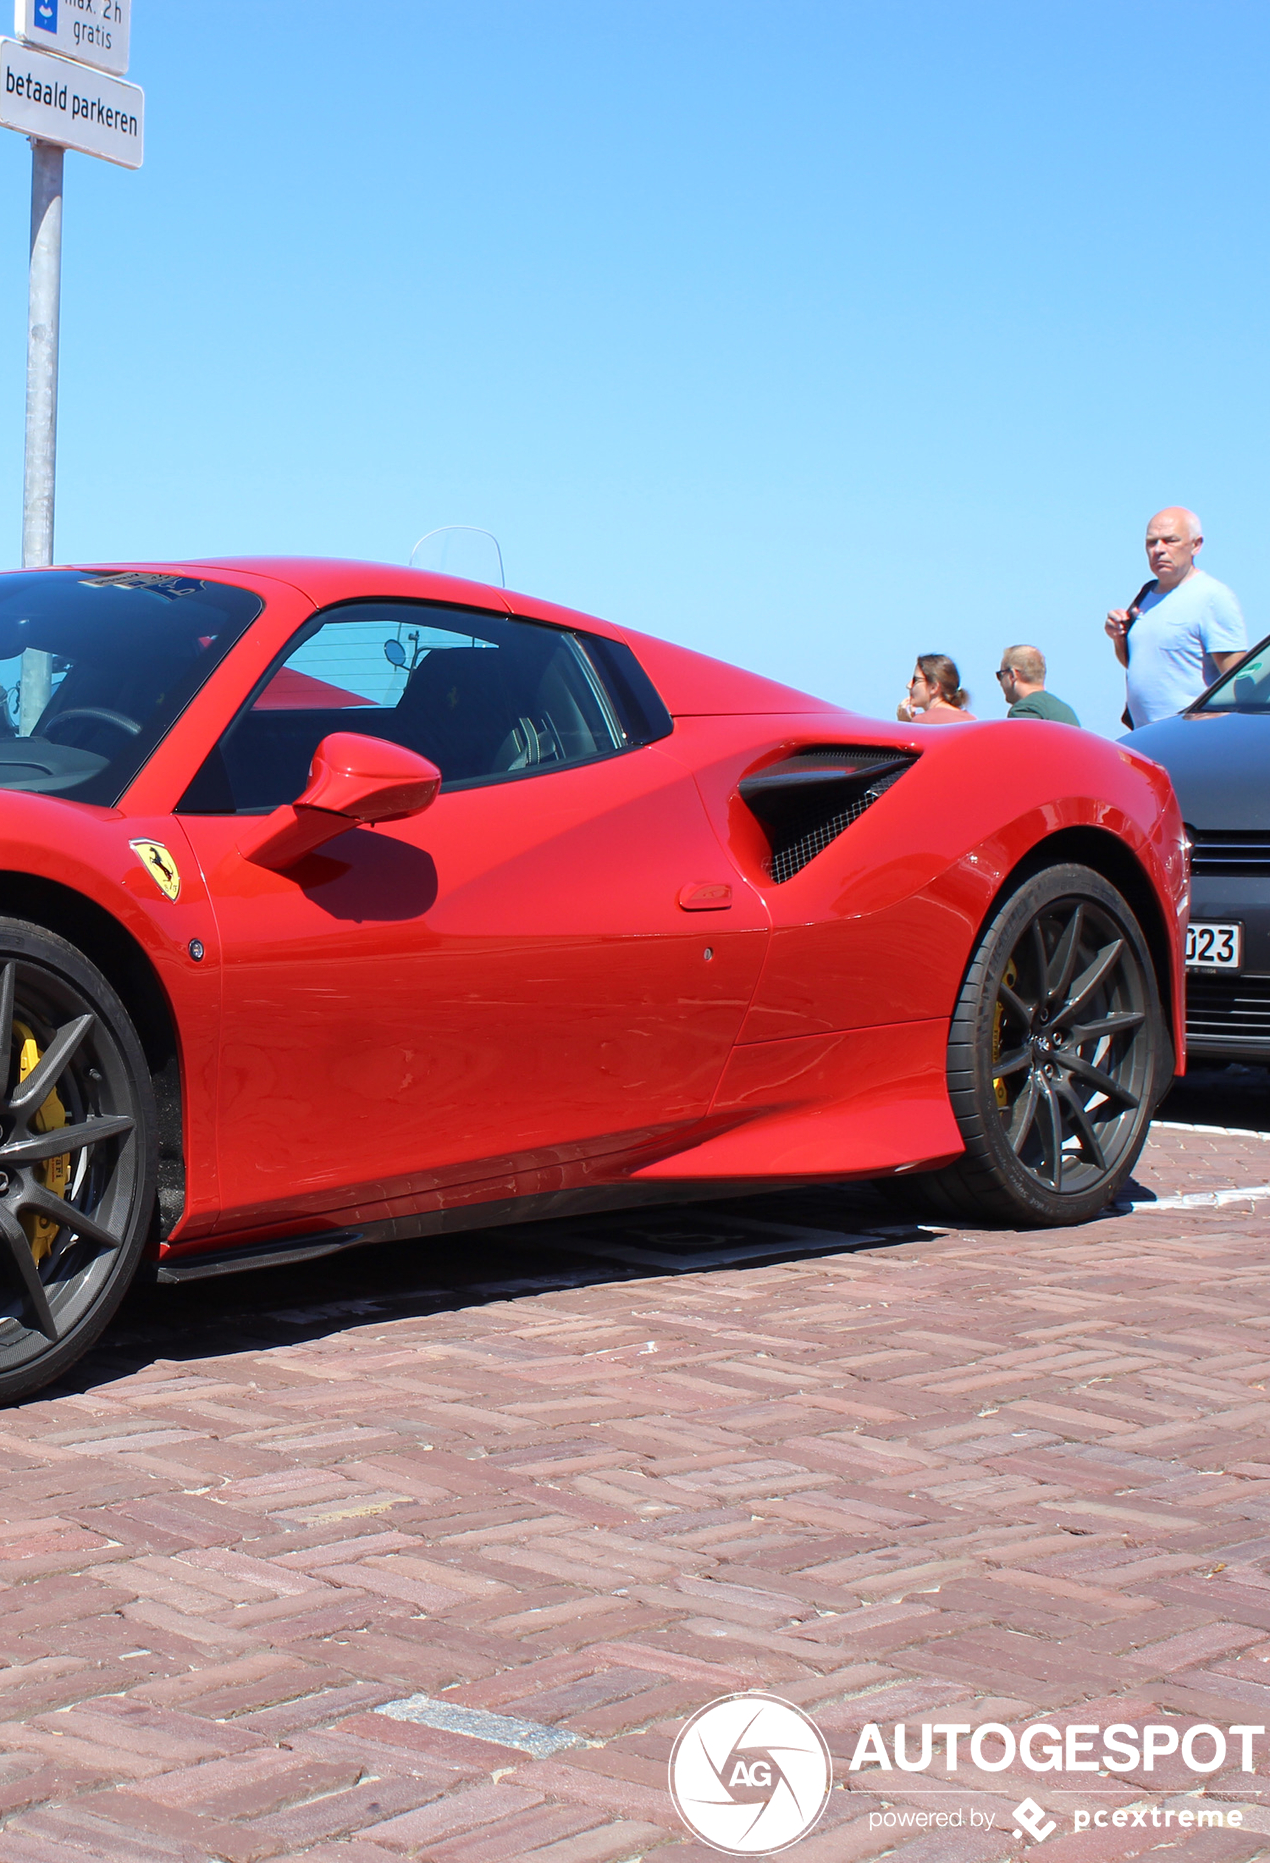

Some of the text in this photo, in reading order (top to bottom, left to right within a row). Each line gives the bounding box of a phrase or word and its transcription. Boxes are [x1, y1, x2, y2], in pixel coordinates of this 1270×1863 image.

[73, 20, 112, 49] gratis
[6, 65, 138, 137] betaald parkeren
